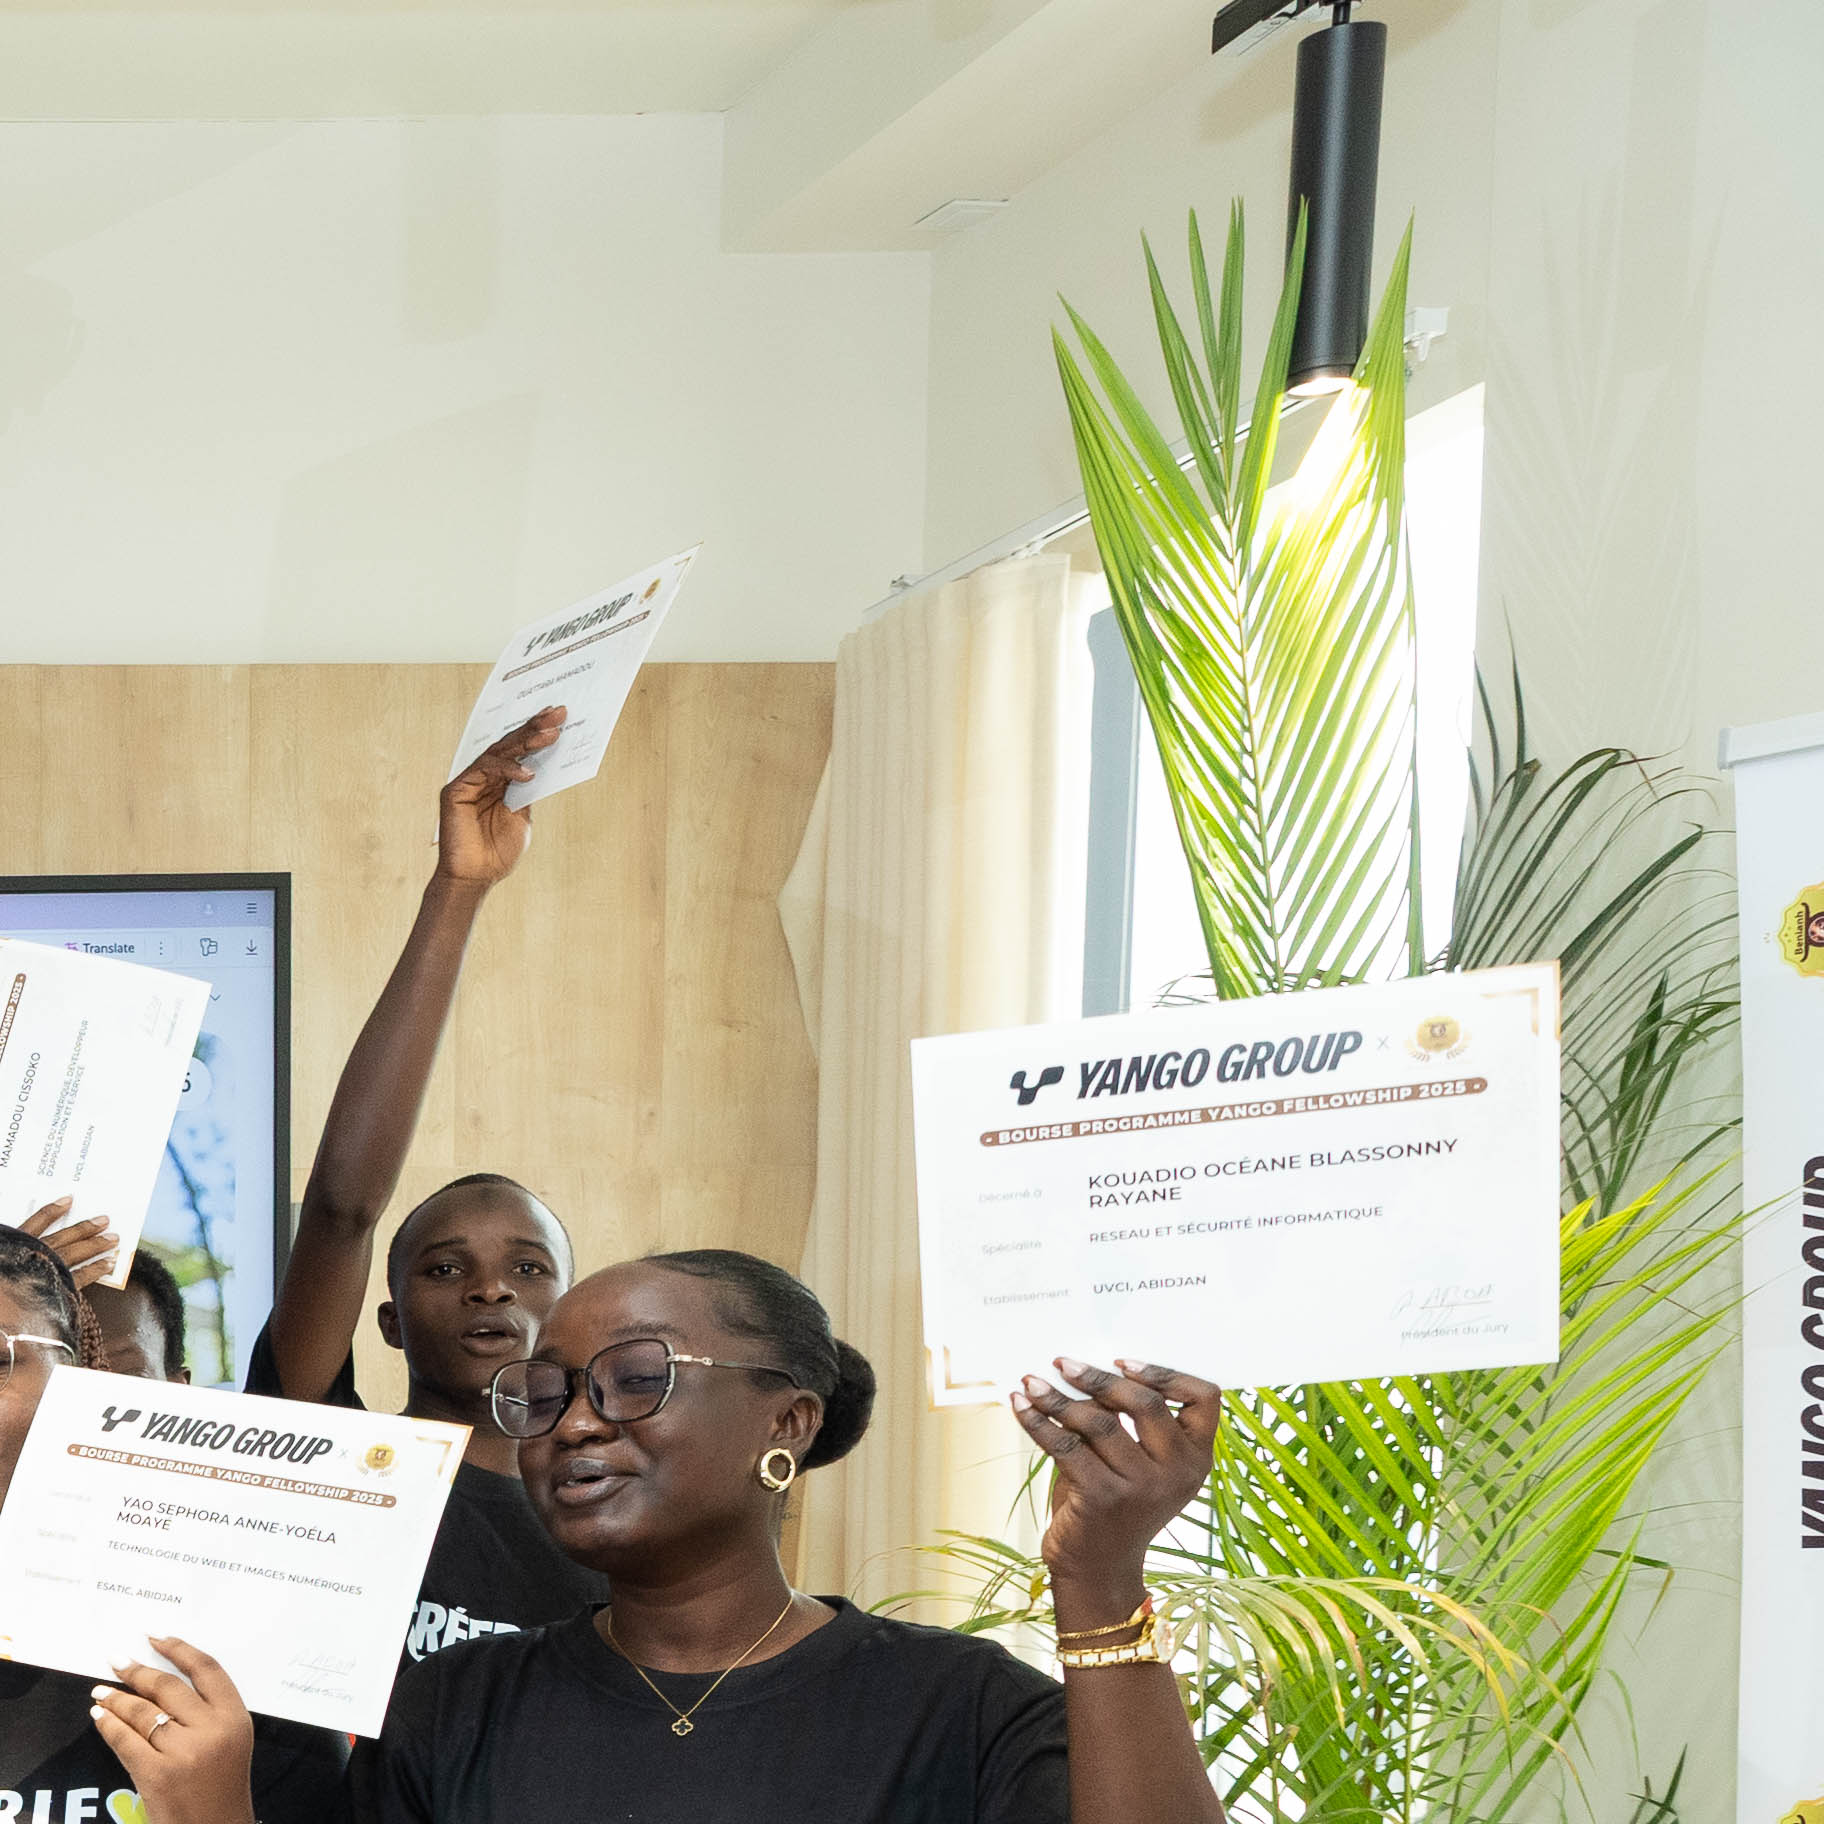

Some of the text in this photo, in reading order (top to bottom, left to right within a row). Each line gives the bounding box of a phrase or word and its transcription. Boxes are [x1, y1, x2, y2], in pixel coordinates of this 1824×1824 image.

[82, 940, 136, 956] Translate
[17, 1051, 40, 1102] CISSOKO
[1077, 1030, 1362, 1099] YANGO GROUP
[997, 1079, 1467, 1145] BOURSE PROGRAMME YANGO FELLOWSHIP 2025
[1088, 1138, 1457, 1189] KOUADIO OCÉANE BLASSONNY
[1089, 1186, 1181, 1208] RAYANE
[1154, 1225, 1172, 1237] ET
[1177, 1217, 1251, 1234] SÉCURITÉ
[1257, 1206, 1382, 1226] INFORMATIQUE
[1137, 1275, 1206, 1289] ABIDJAN
[139, 1411, 333, 1464] YANGO GROUP
[77, 1445, 384, 1507] BOURSE PROGRAMME YANGO FELLOWSHIP 2025
[123, 1496, 335, 1544] YAO SEPHORA ANNE-YOÉLA
[181, 1553, 199, 1564] DU
[200, 1557, 226, 1569] WEB
[227, 1562, 241, 1571] ET
[135, 1588, 182, 1604] ABIDJAN
